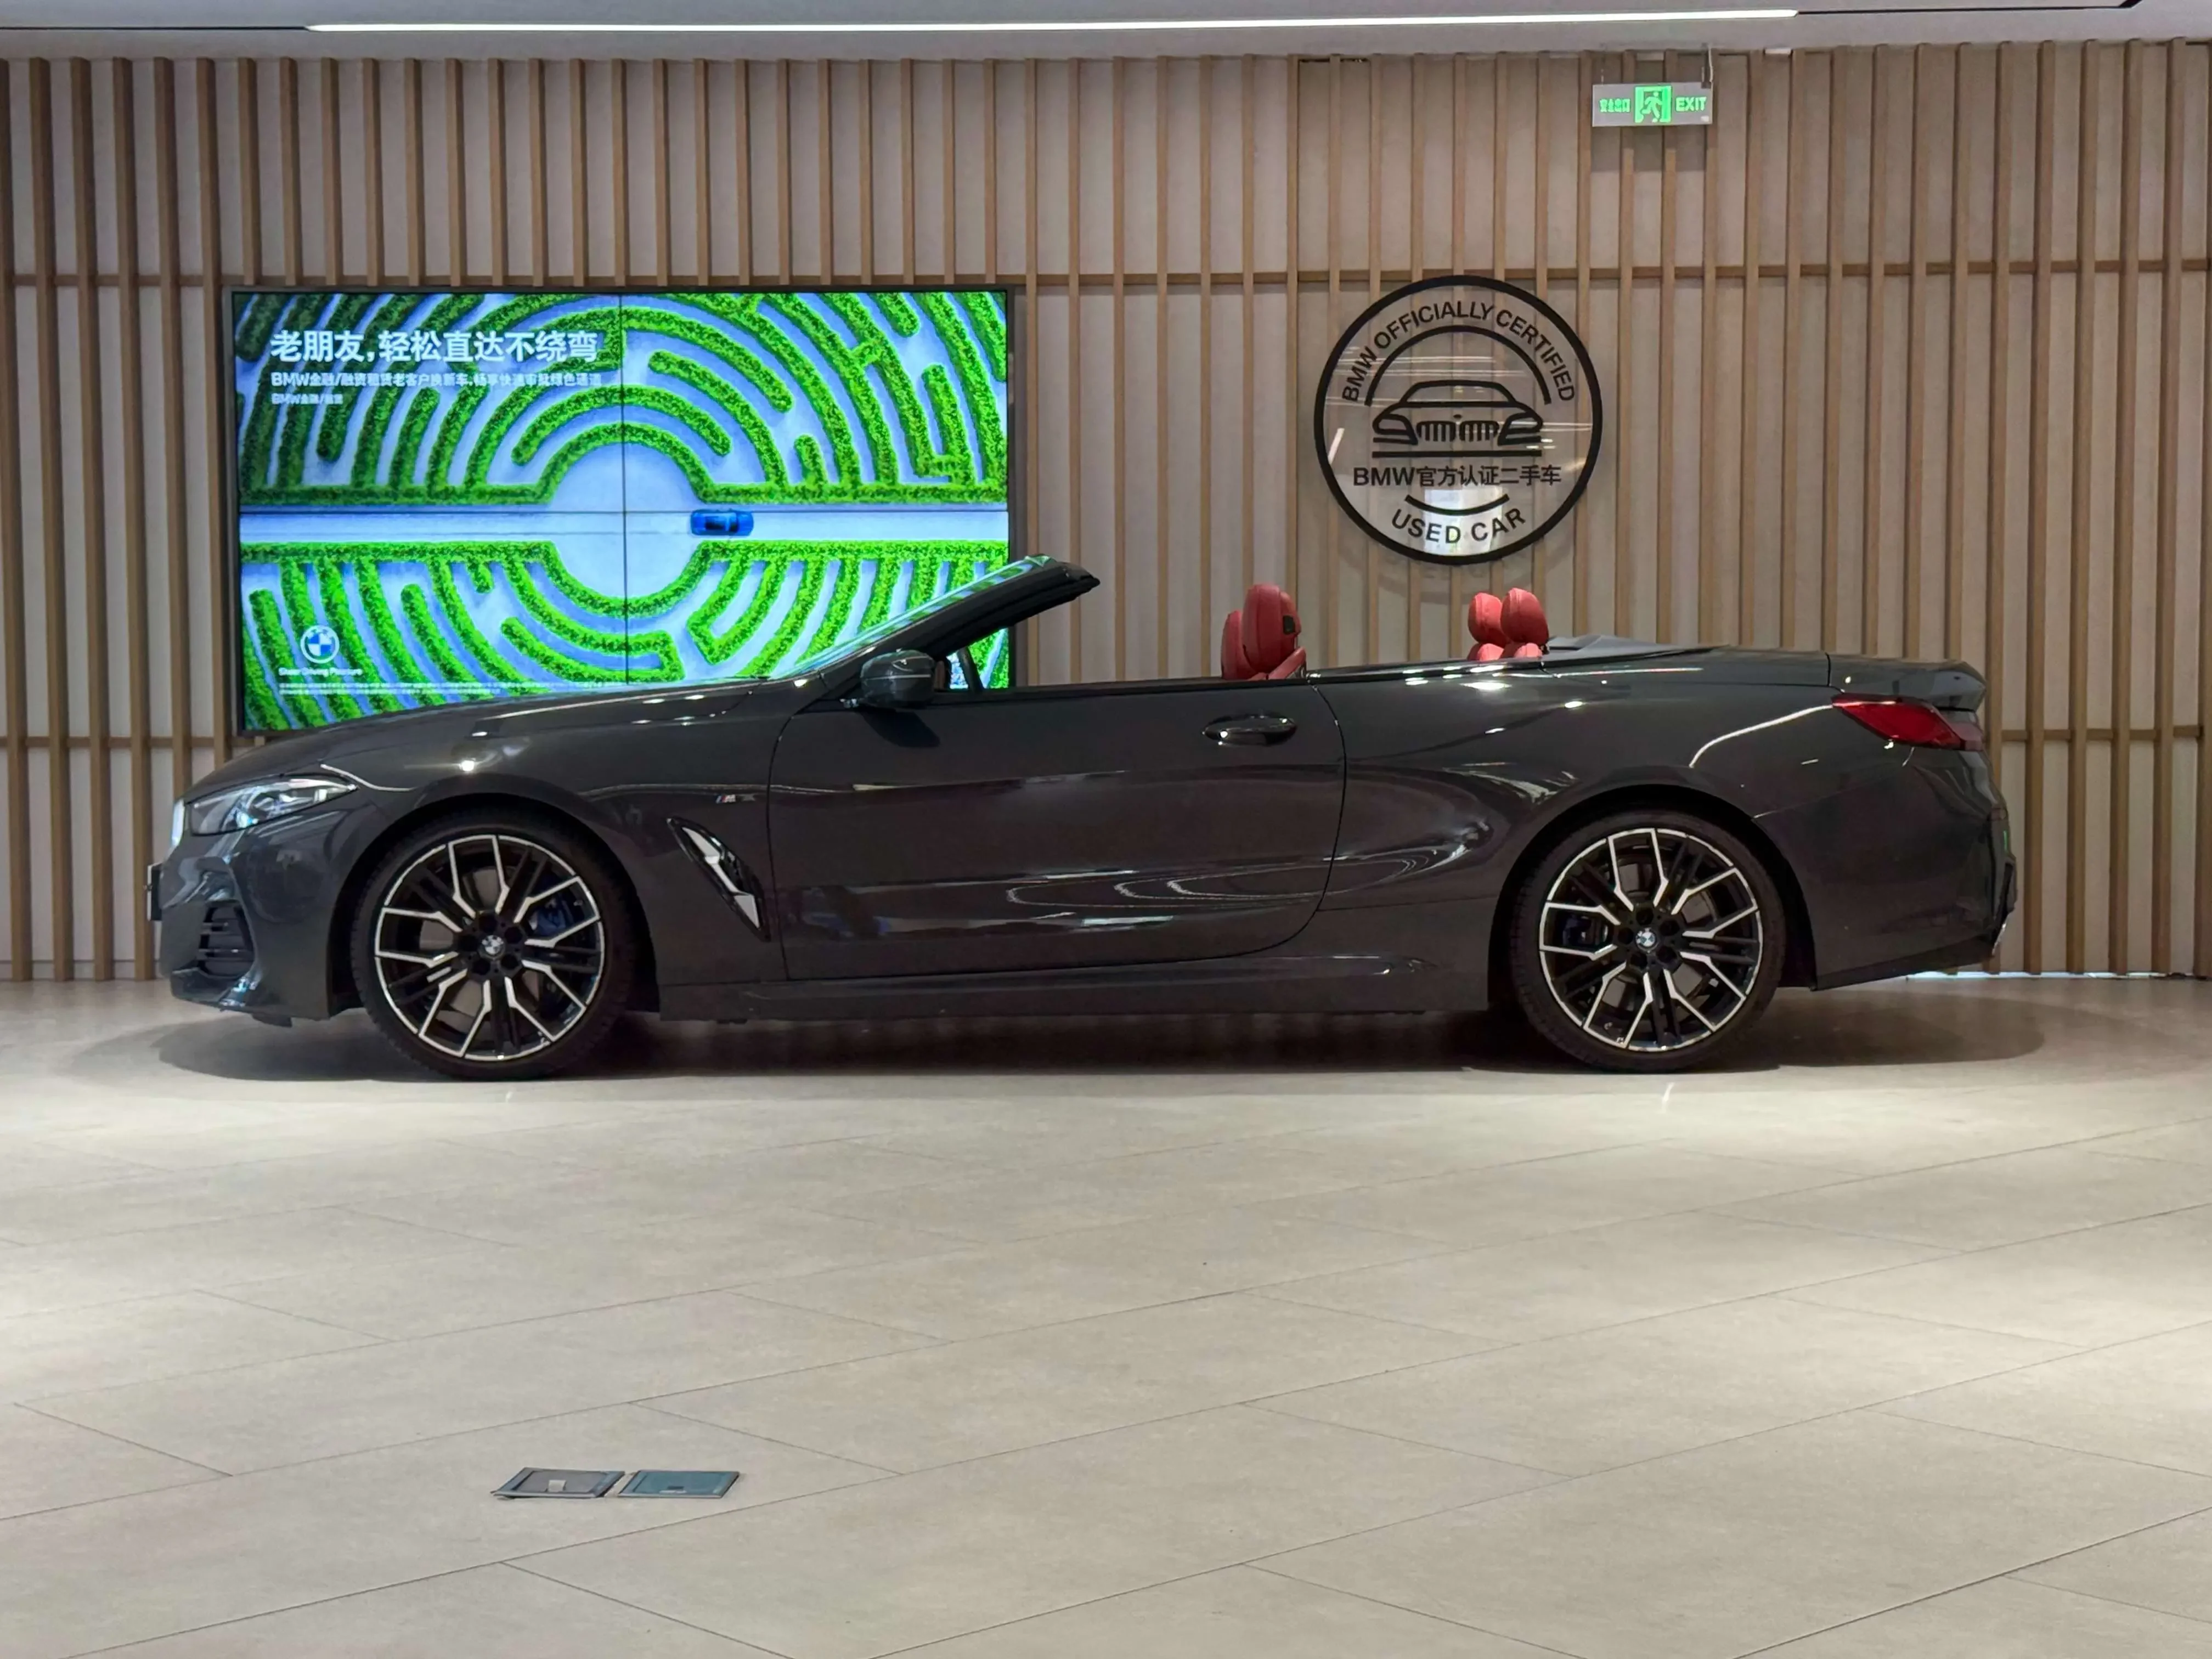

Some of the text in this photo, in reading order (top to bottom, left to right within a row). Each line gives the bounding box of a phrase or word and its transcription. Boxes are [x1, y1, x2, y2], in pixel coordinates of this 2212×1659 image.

[1675, 97, 1707, 112] EXIT
[1341, 301, 1576, 403] BMW OFFICIALLY CERTIFIED
[1353, 465, 1562, 487] BMW官方认证二手车
[1391, 507, 1526, 544] USED CAR
